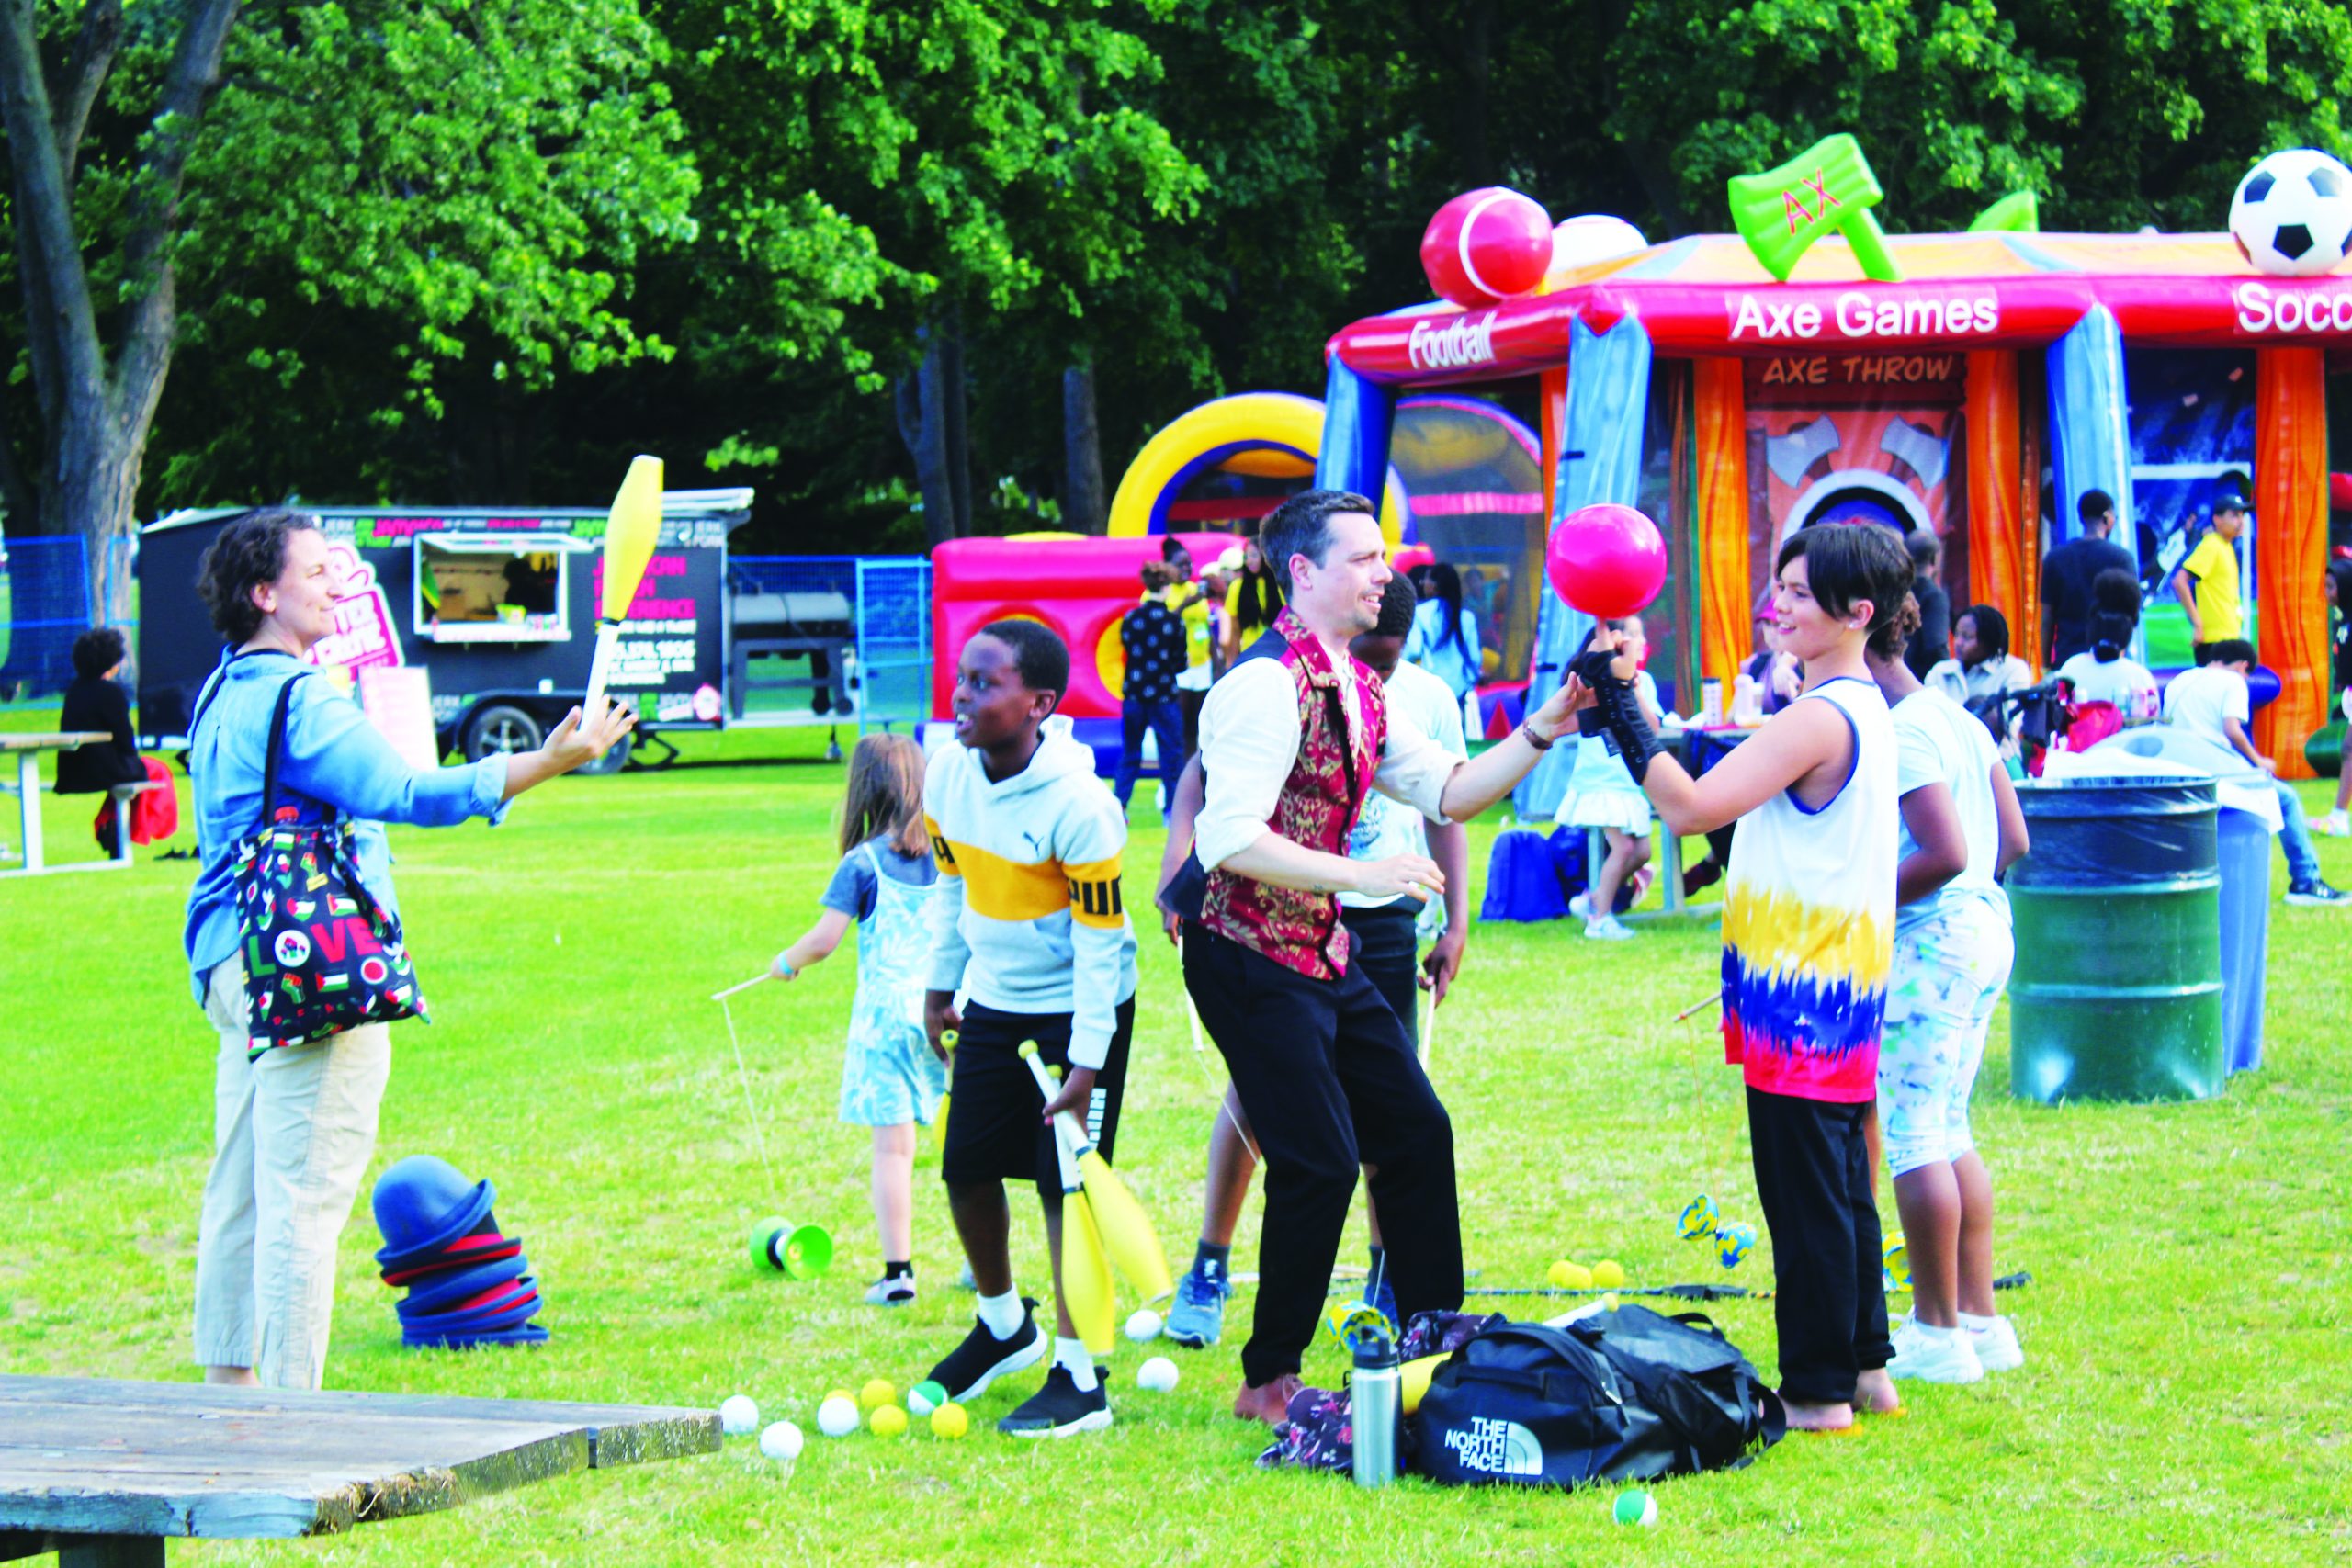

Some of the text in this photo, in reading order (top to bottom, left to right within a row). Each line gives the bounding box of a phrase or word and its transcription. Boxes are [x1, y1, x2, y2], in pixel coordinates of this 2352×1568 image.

[1782, 167, 1841, 235] AX
[1731, 291, 1998, 339] Axe Games
[1409, 309, 1498, 369] Football
[1762, 355, 1953, 384] AXE THROW
[1471, 1416, 1508, 1438] THE
[1444, 1429, 1506, 1455] NORTH
[1459, 1450, 1504, 1473] FACE
